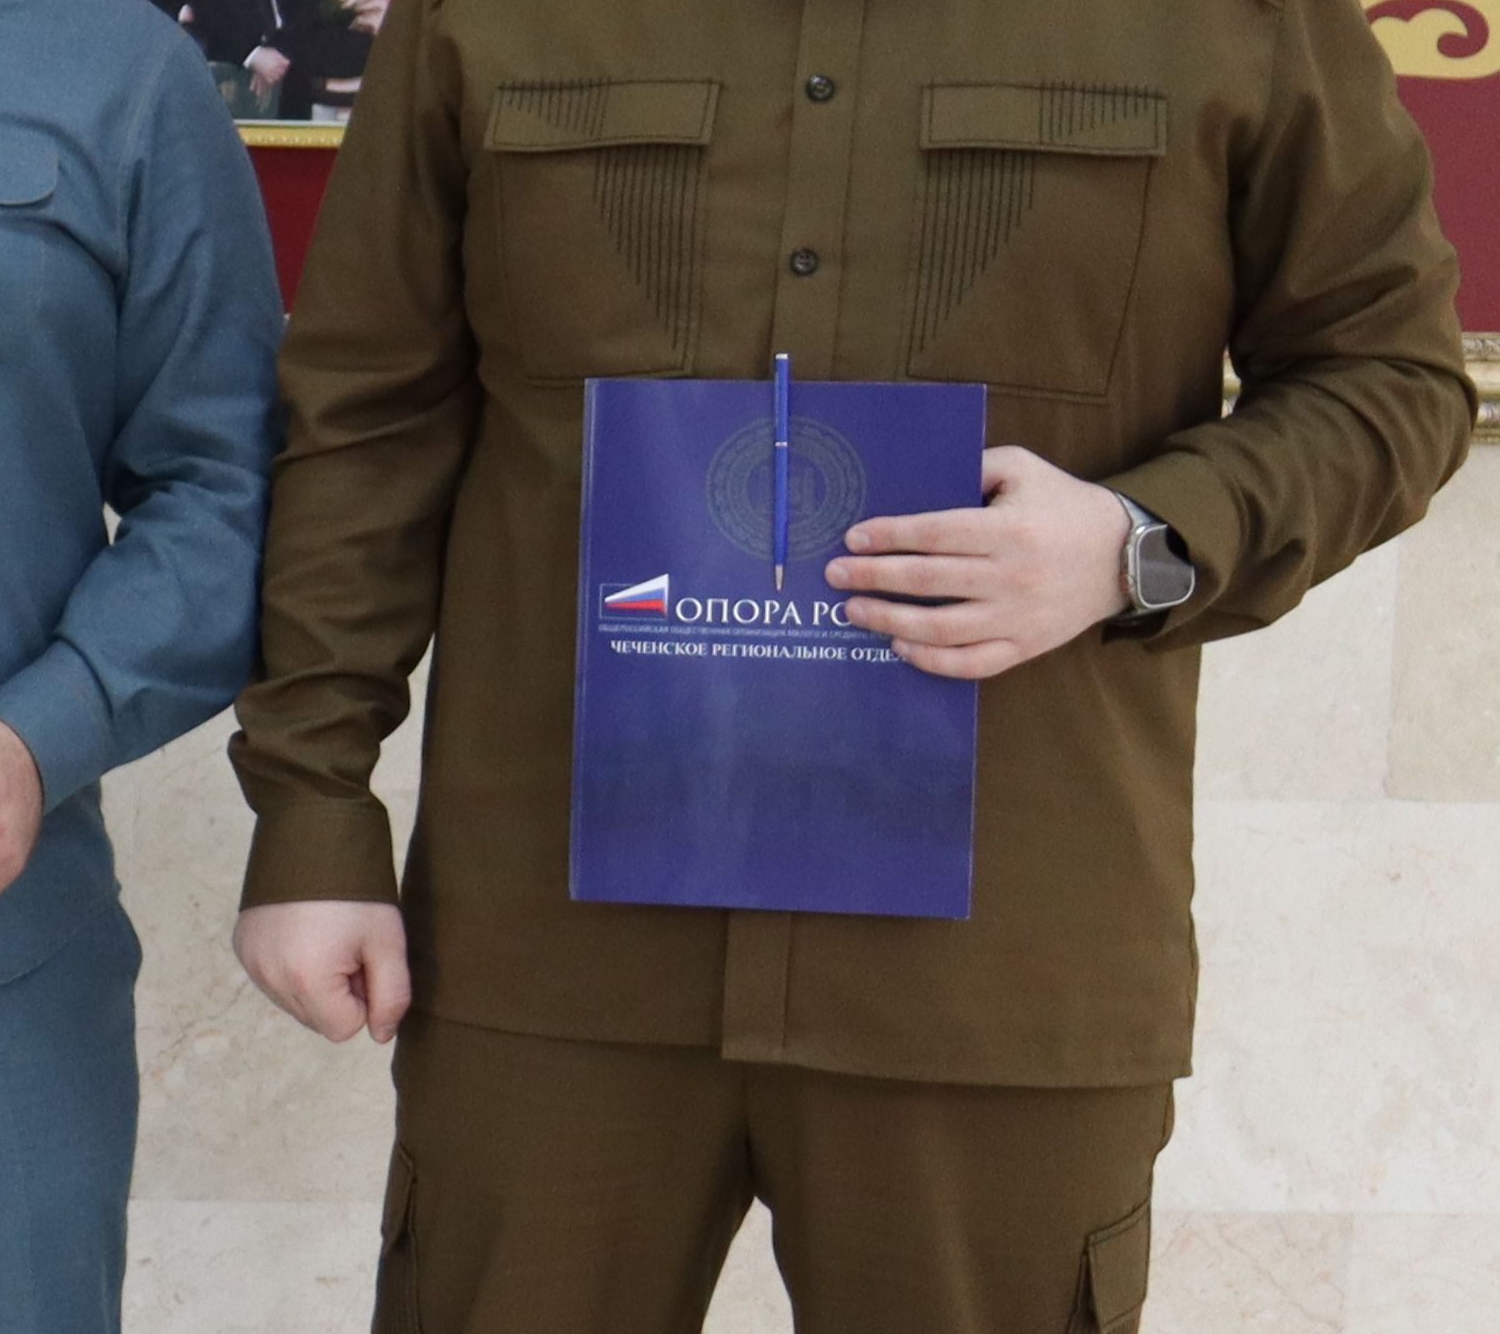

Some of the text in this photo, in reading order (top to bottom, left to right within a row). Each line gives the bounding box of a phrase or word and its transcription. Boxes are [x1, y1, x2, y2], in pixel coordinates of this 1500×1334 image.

[675, 596, 803, 625] ОПОРА
[610, 639, 708, 656] ЧЕЧЕНСКОЕ
[711, 642, 848, 660] РЕГИОНАЛЬНОЕ
